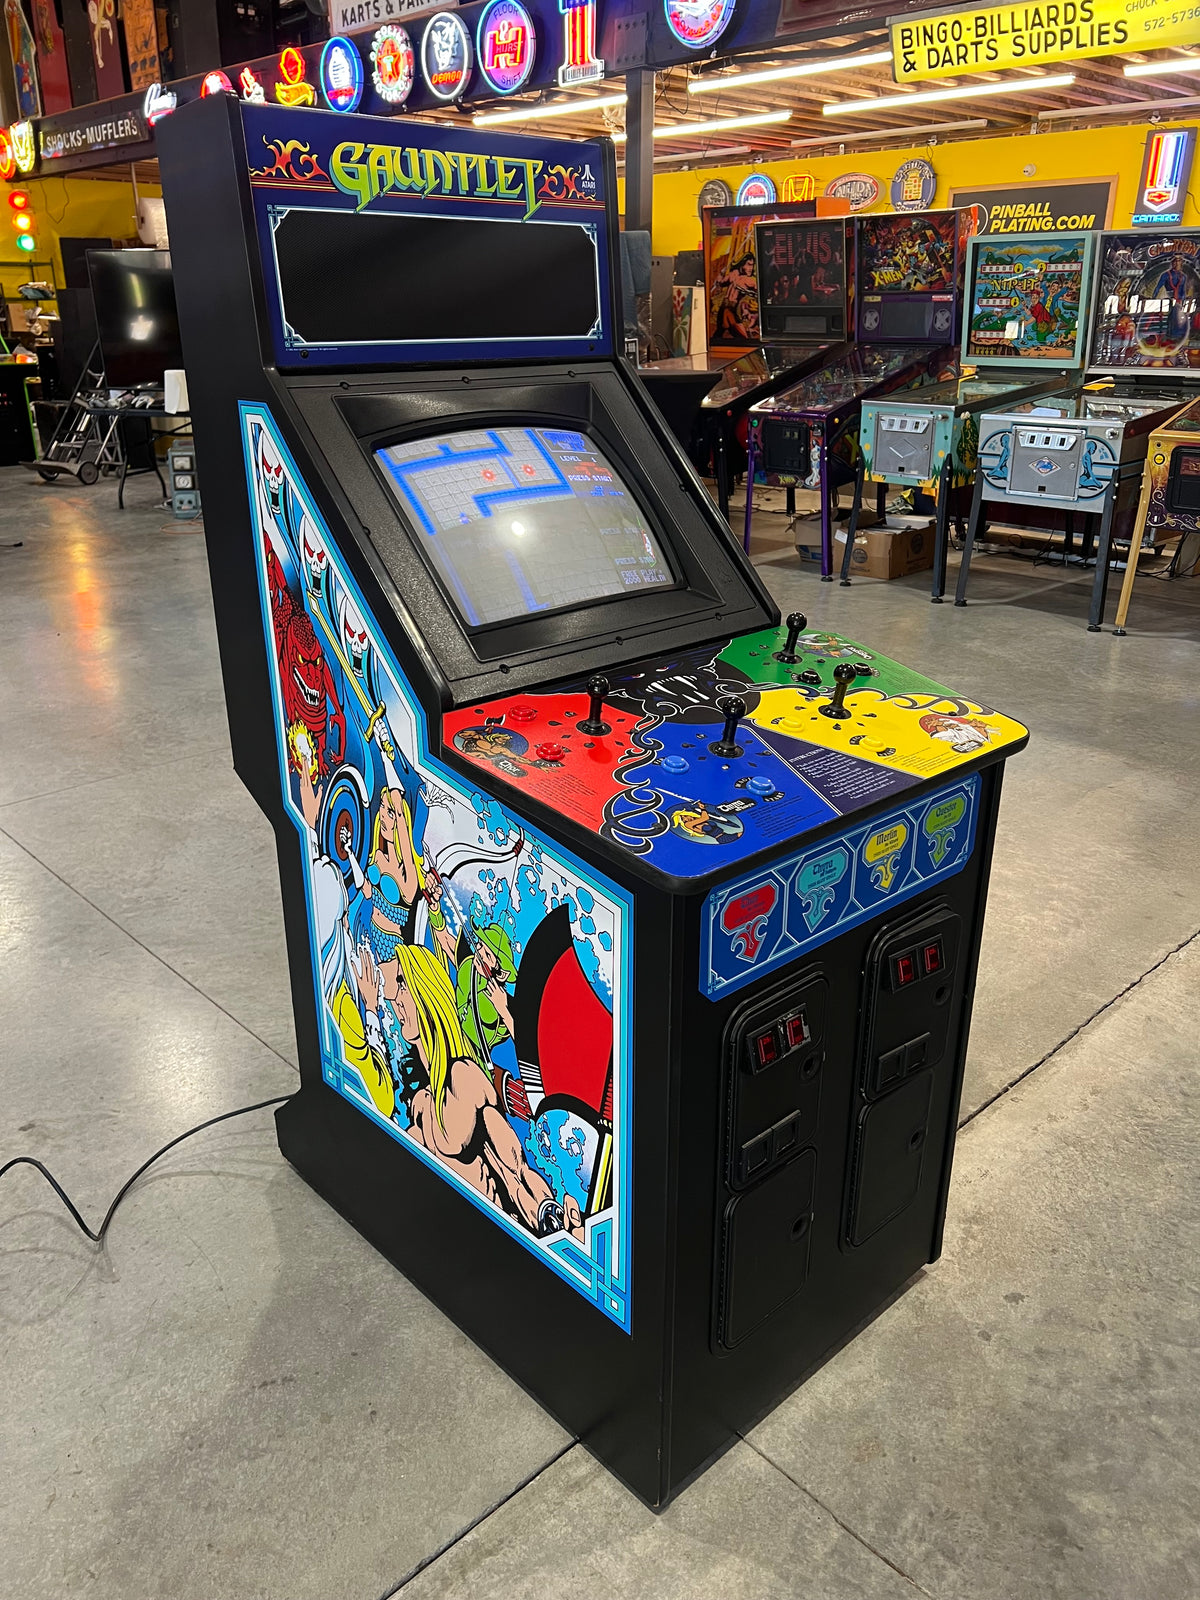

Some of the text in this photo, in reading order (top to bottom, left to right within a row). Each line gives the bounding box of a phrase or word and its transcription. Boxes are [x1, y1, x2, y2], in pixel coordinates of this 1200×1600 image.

[341, 0, 380, 27] KARTS
[386, 0, 394, 15] &
[493, 3, 519, 19] FLOOR
[1144, 6, 1200, 31] 572-5736
[901, 0, 1094, 50] BINGO-BILLIARDS
[903, 20, 1129, 73] & DARTS SUPPLIES
[501, 72, 522, 87] SHIFT
[46, 118, 138, 152] SHOCKS-MUFFLERS
[329, 141, 544, 223] GAUNTLET
[581, 181, 596, 189] ATARI
[989, 202, 1052, 219] PINBALL
[1132, 213, 1180, 223] CAMARO
[989, 214, 1096, 233] PLATING.COM
[871, 270, 904, 287] X-MEN
